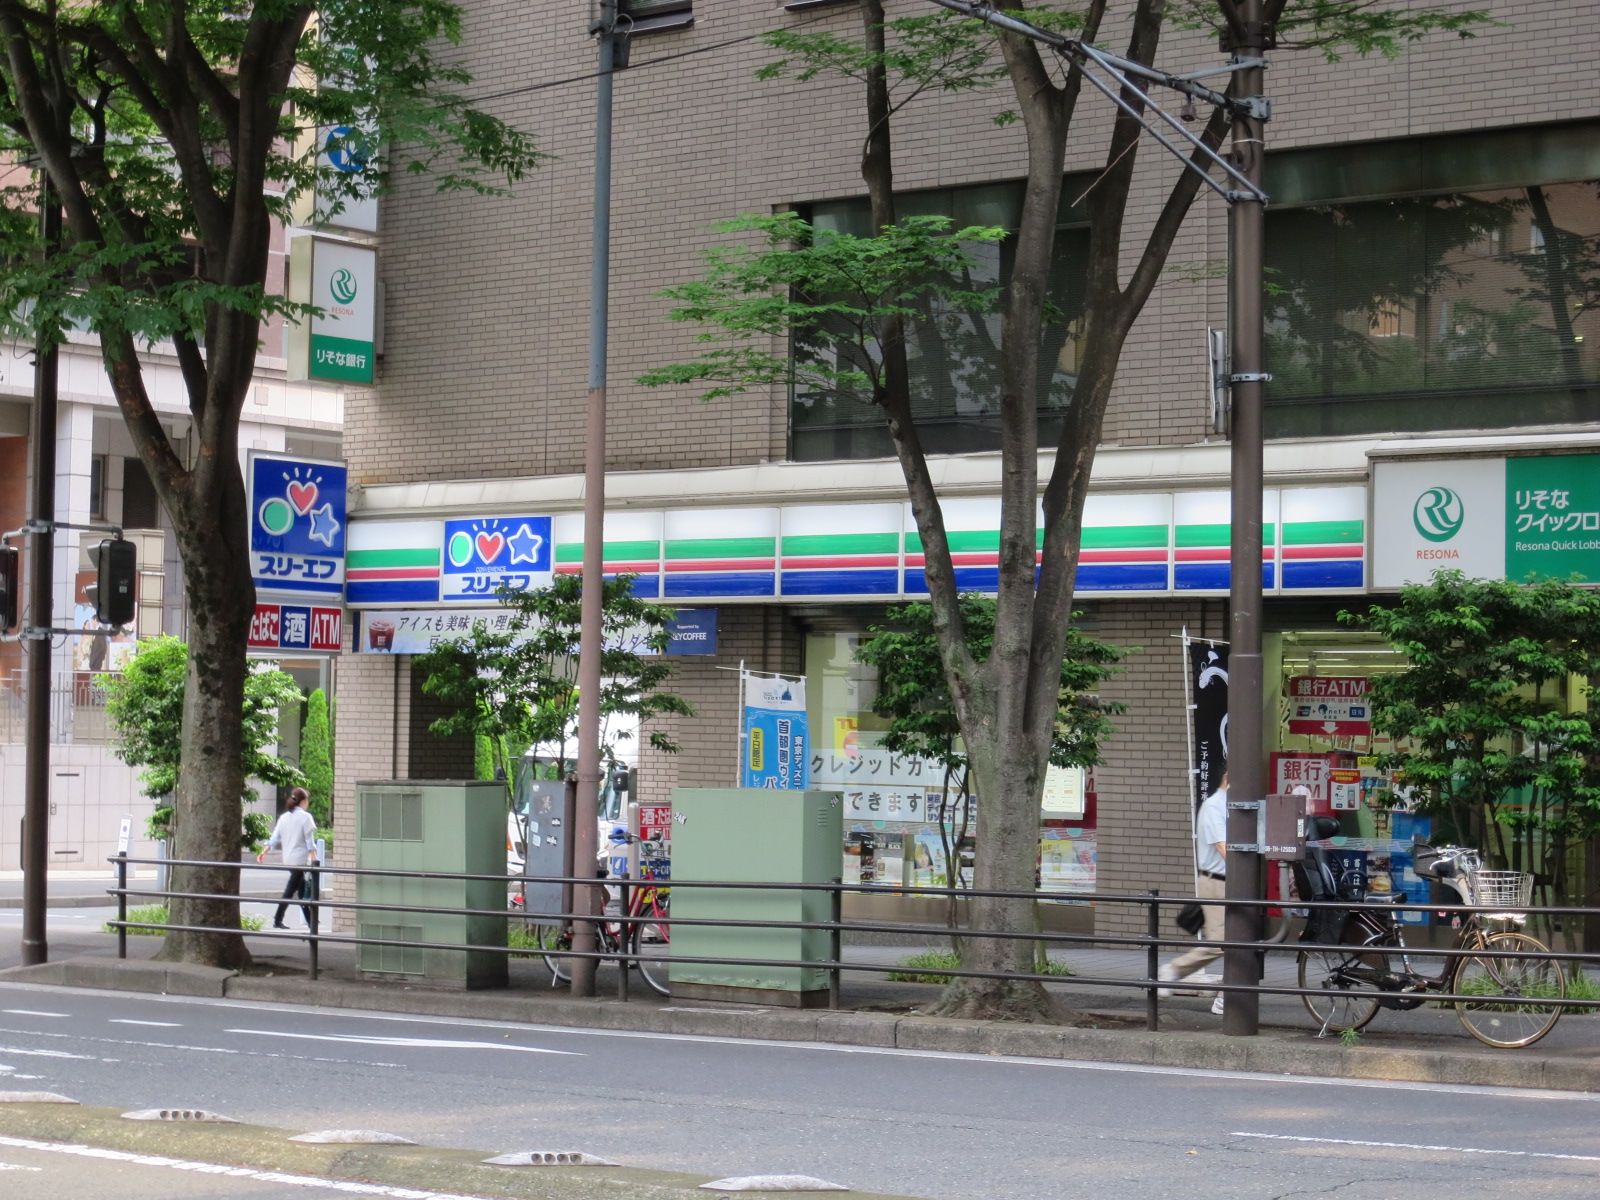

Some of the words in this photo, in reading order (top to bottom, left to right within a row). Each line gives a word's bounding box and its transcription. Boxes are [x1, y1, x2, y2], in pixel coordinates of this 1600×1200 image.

[316, 349, 366, 369] りそな銀行
[1515, 489, 1570, 510] りそな
[1515, 512, 1600, 533] クイックロ
[1416, 549, 1460, 560] RESONA
[1515, 541, 1550, 551] Resona
[1551, 540, 1577, 552] Quick
[259, 556, 337, 579] スリーエフ
[461, 575, 531, 594] スリーエフ
[284, 611, 307, 643] 酒
[311, 613, 340, 645] ATM
[1298, 680, 1366, 695] 銀行ATM
[811, 755, 943, 776] クレジットカー
[1284, 761, 1321, 781] 銀行
[848, 792, 922, 812] できます
